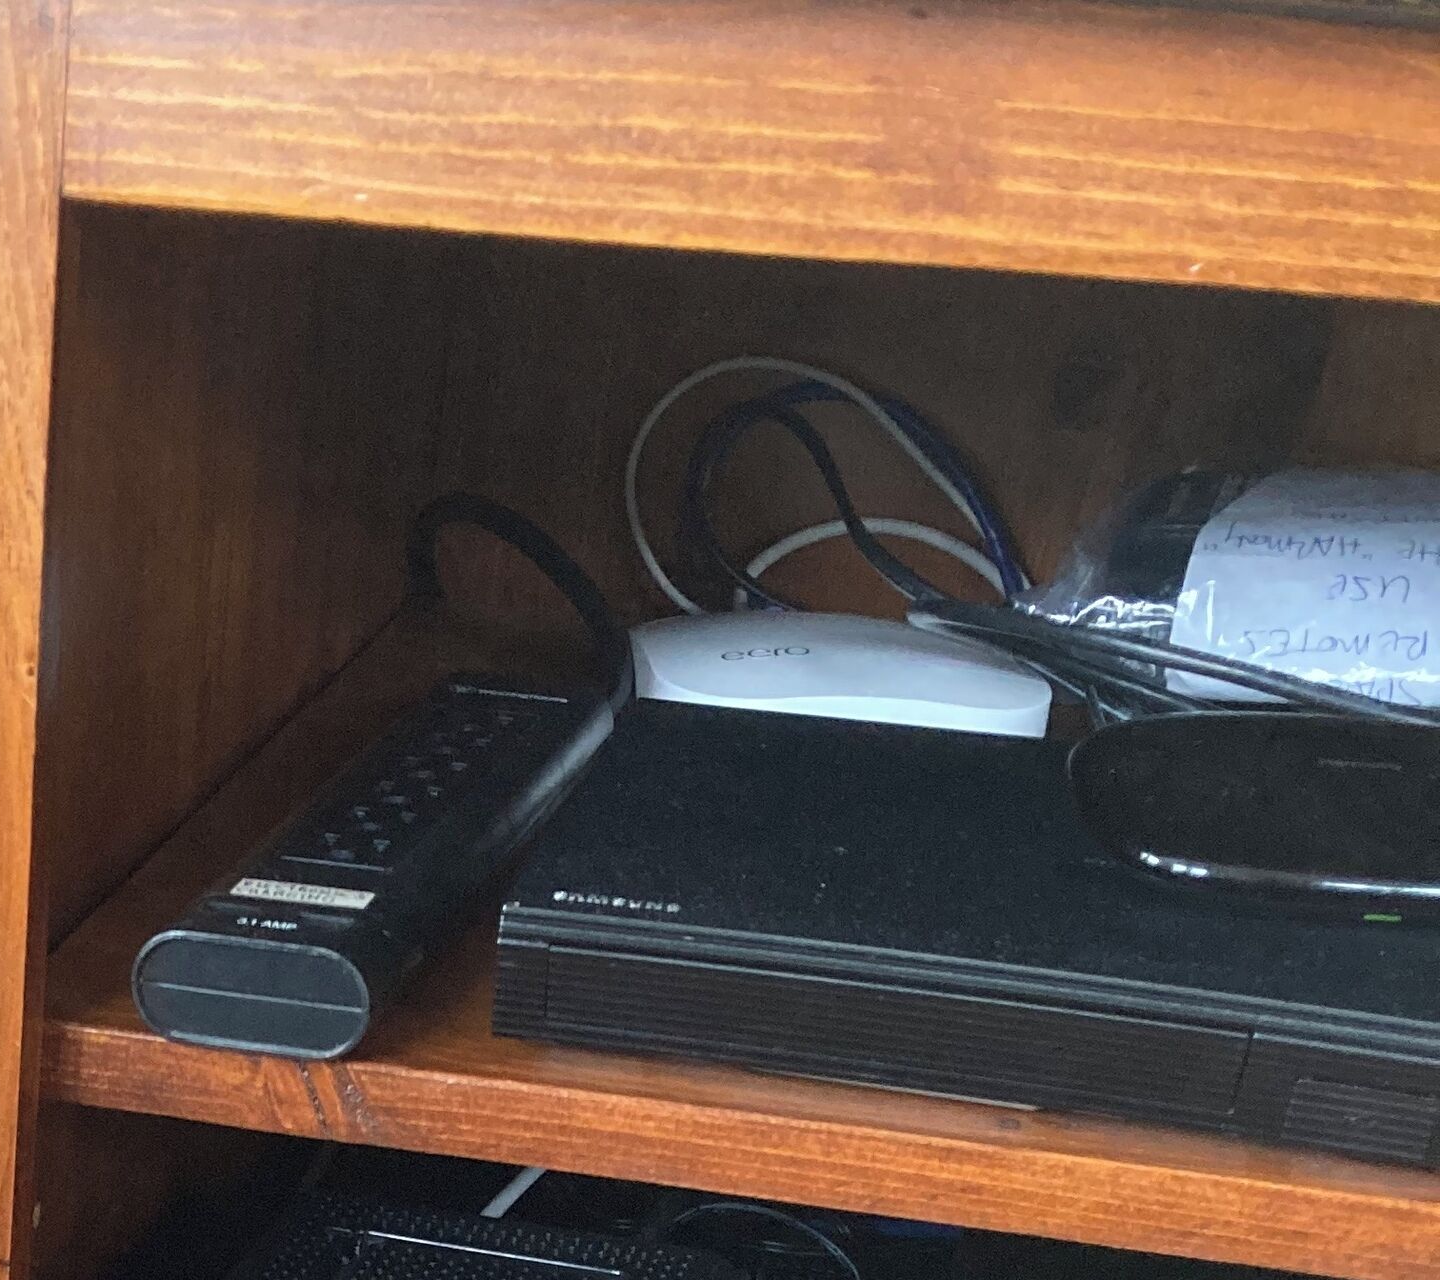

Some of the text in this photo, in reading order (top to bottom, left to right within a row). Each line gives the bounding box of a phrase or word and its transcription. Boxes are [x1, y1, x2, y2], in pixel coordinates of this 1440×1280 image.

[1325, 573, 1411, 604] USE
[720, 644, 811, 662] eero
[1242, 628, 1429, 662] REMOTES
